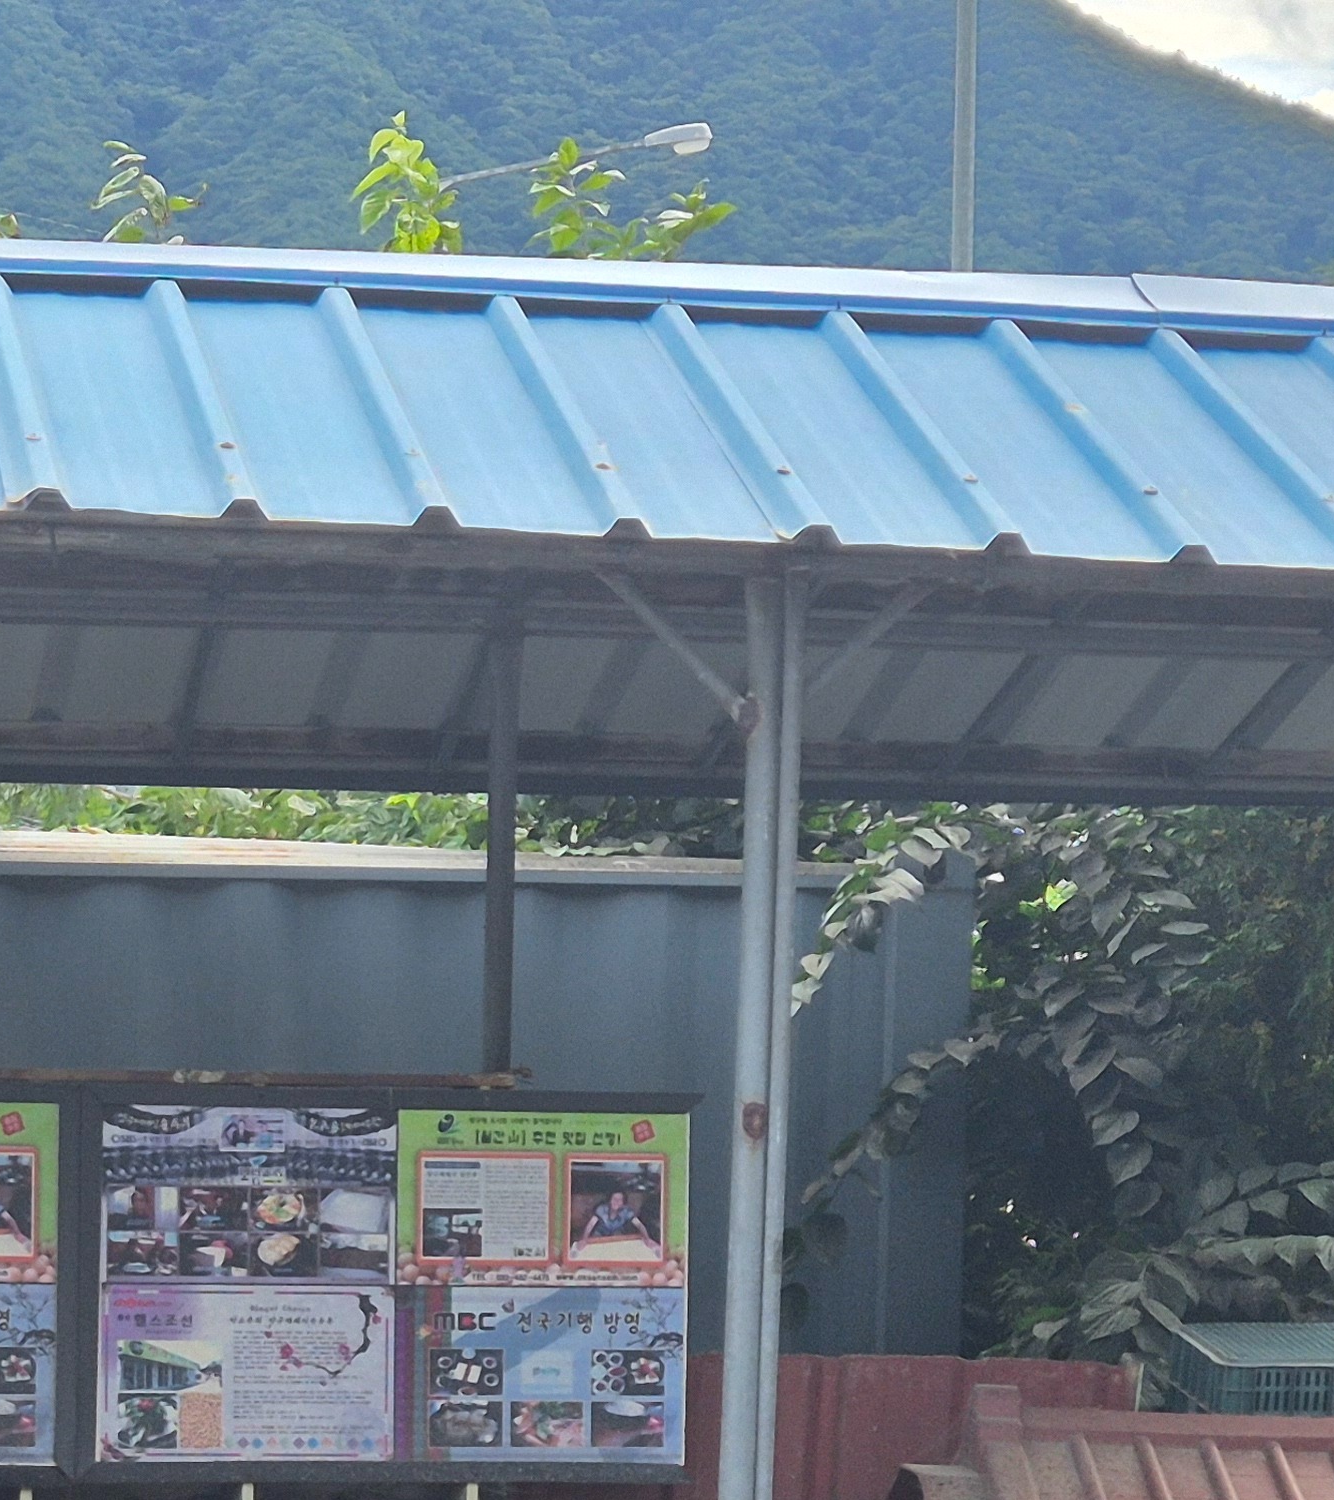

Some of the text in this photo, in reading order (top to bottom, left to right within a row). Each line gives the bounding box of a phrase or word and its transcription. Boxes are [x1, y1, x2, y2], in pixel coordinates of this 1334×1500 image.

[433, 1311, 640, 1335] MBC 전국기행 방영
